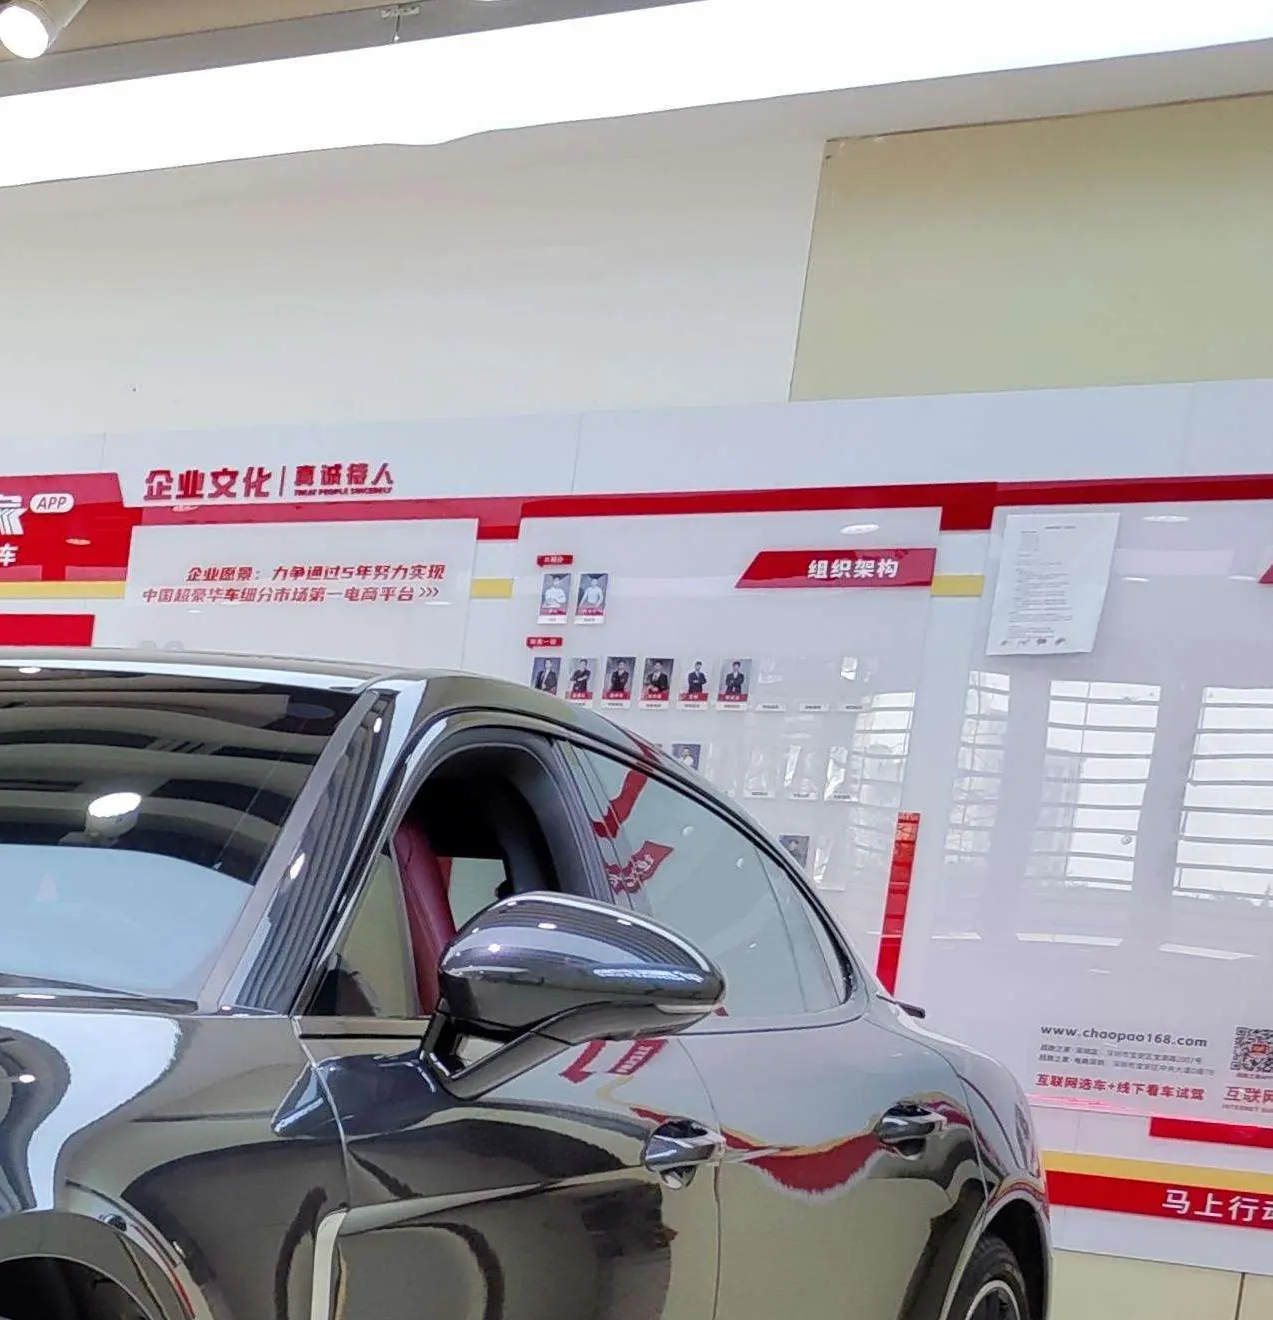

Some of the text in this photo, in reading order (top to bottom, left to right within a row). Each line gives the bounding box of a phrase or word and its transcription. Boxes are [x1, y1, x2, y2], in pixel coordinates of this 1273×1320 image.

[143, 462, 394, 500] 企业文化 真诚待人
[35, 496, 69, 511] APP
[807, 558, 899, 579] 组织架构
[1040, 1025, 1208, 1047] www.chaopao168.com
[1035, 1073, 1205, 1101] 互联网选车+线下看车试驾
